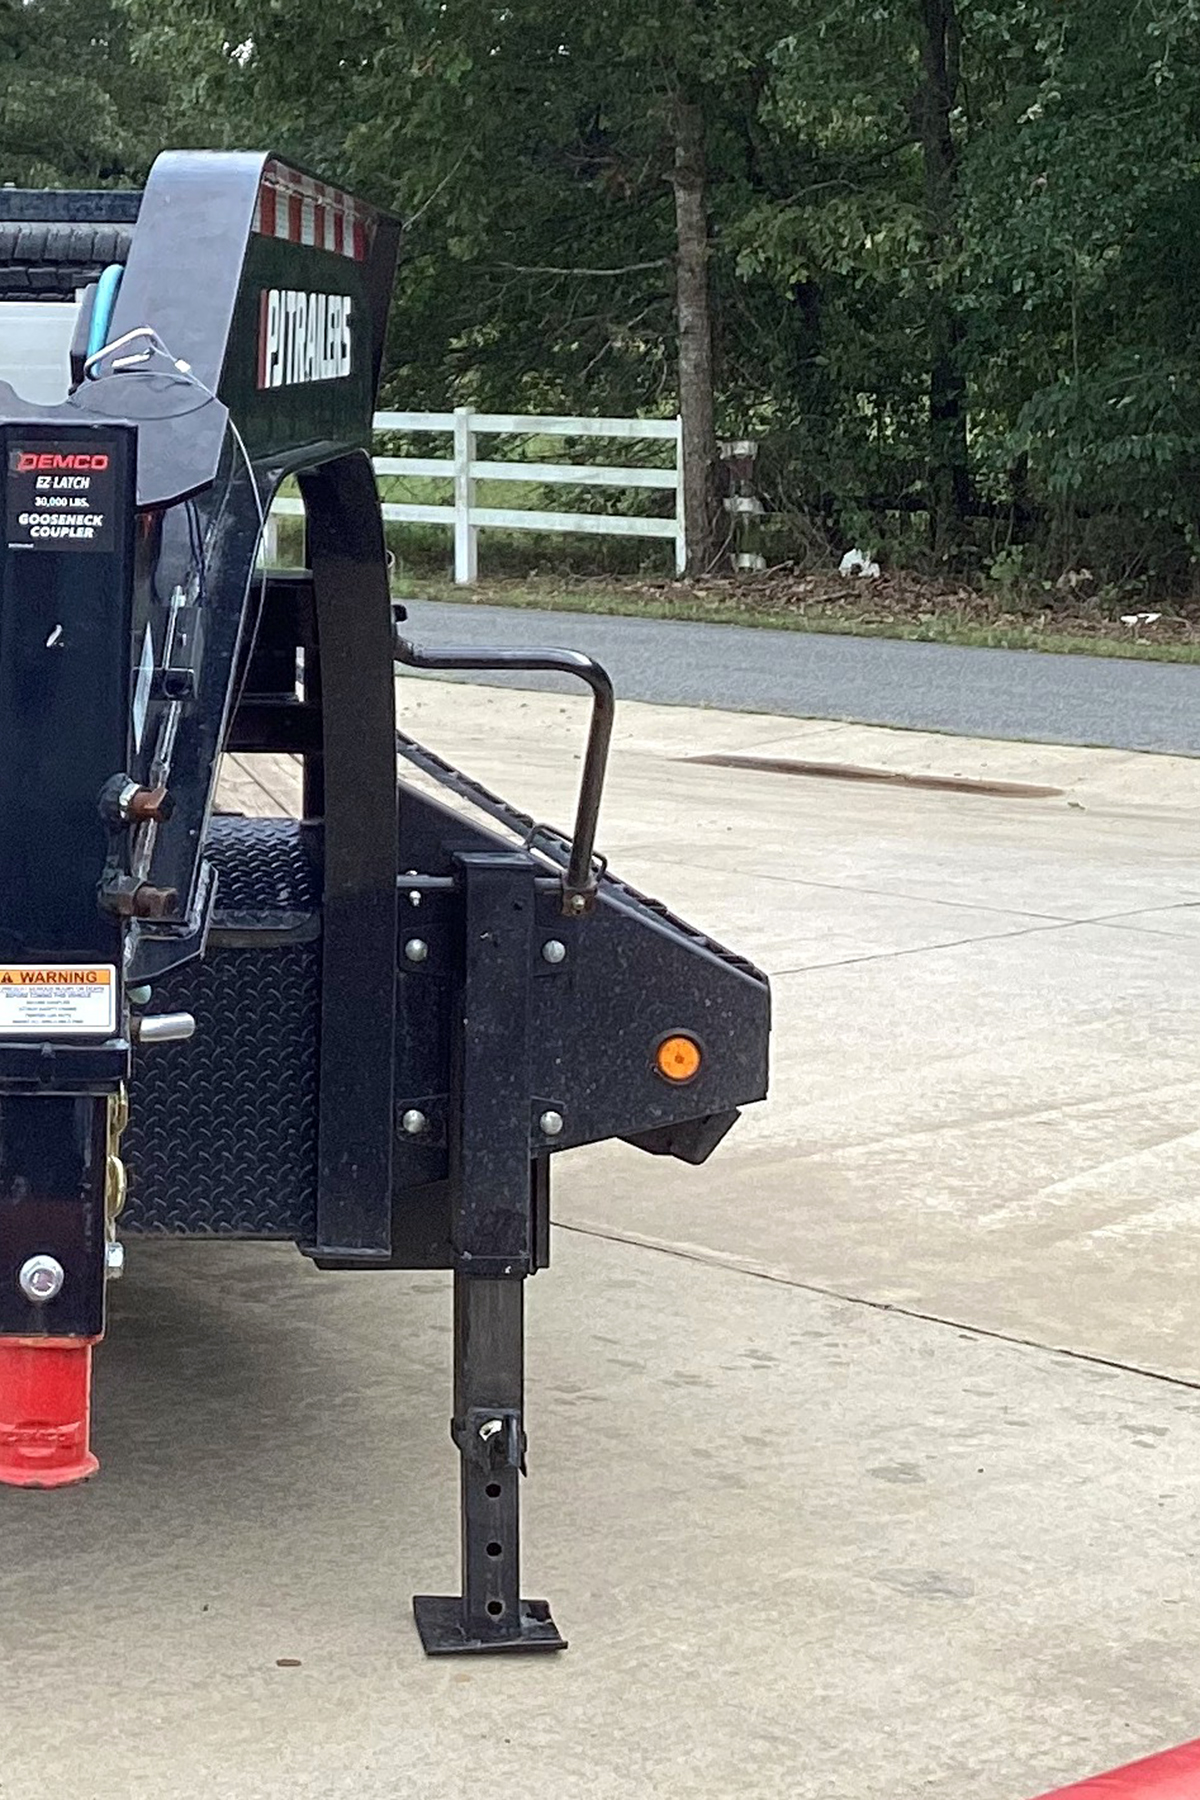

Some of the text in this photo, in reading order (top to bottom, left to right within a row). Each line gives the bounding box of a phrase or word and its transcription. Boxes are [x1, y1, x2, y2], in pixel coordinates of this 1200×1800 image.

[17, 453, 108, 471] DEMCO
[35, 475, 91, 489] EZ LATCH
[34, 496, 68, 508] 30,000
[18, 513, 104, 526] GOOSENECK
[29, 526, 95, 538] COUPLER
[20, 971, 98, 983] WARNING
